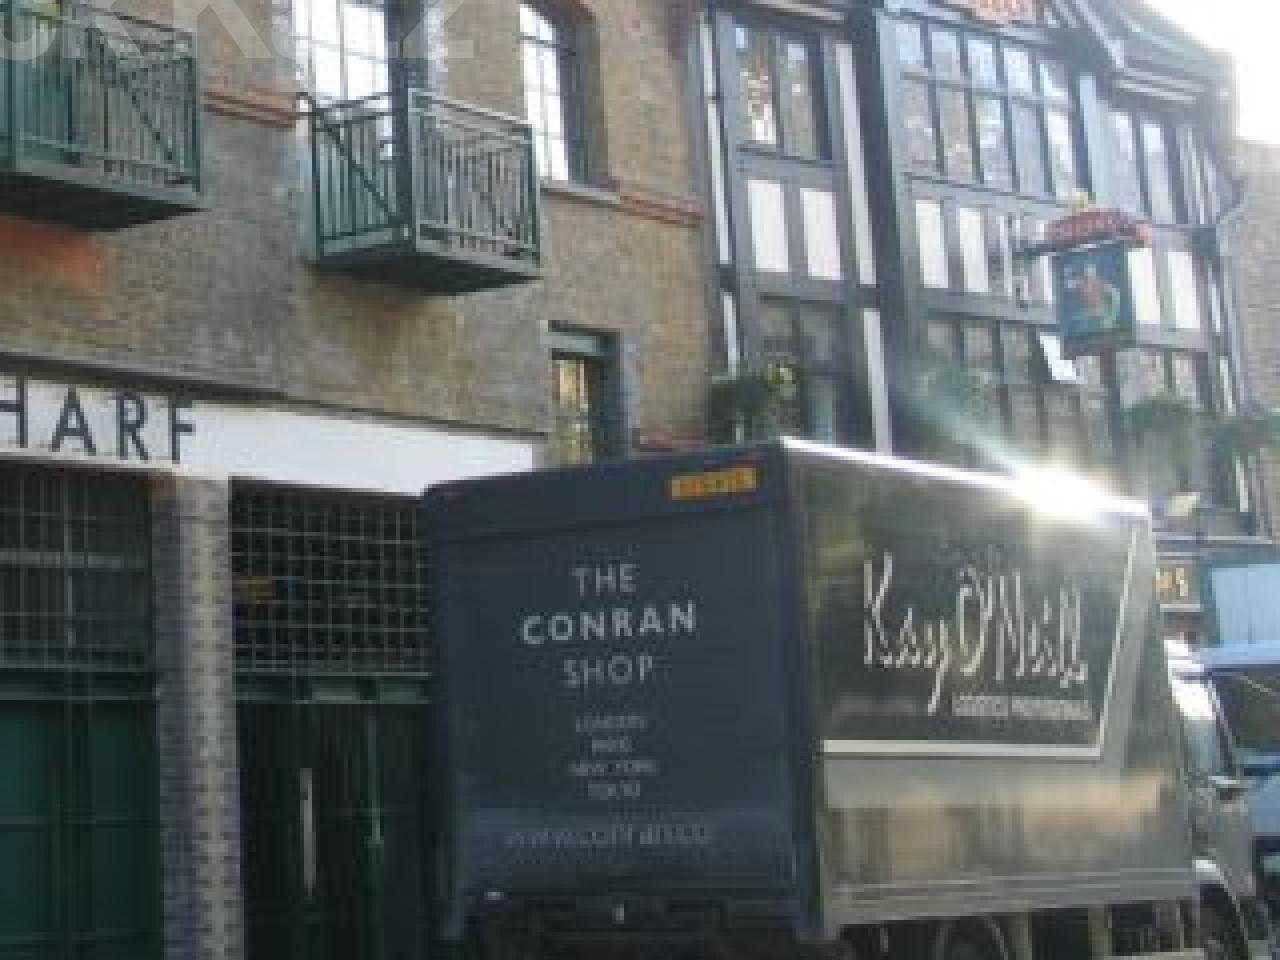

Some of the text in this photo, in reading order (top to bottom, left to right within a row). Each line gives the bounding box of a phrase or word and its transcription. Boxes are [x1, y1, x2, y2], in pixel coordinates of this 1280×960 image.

[574, 563, 638, 596] THE
[522, 600, 697, 645] CONRAN
[563, 654, 654, 688] SHOP
